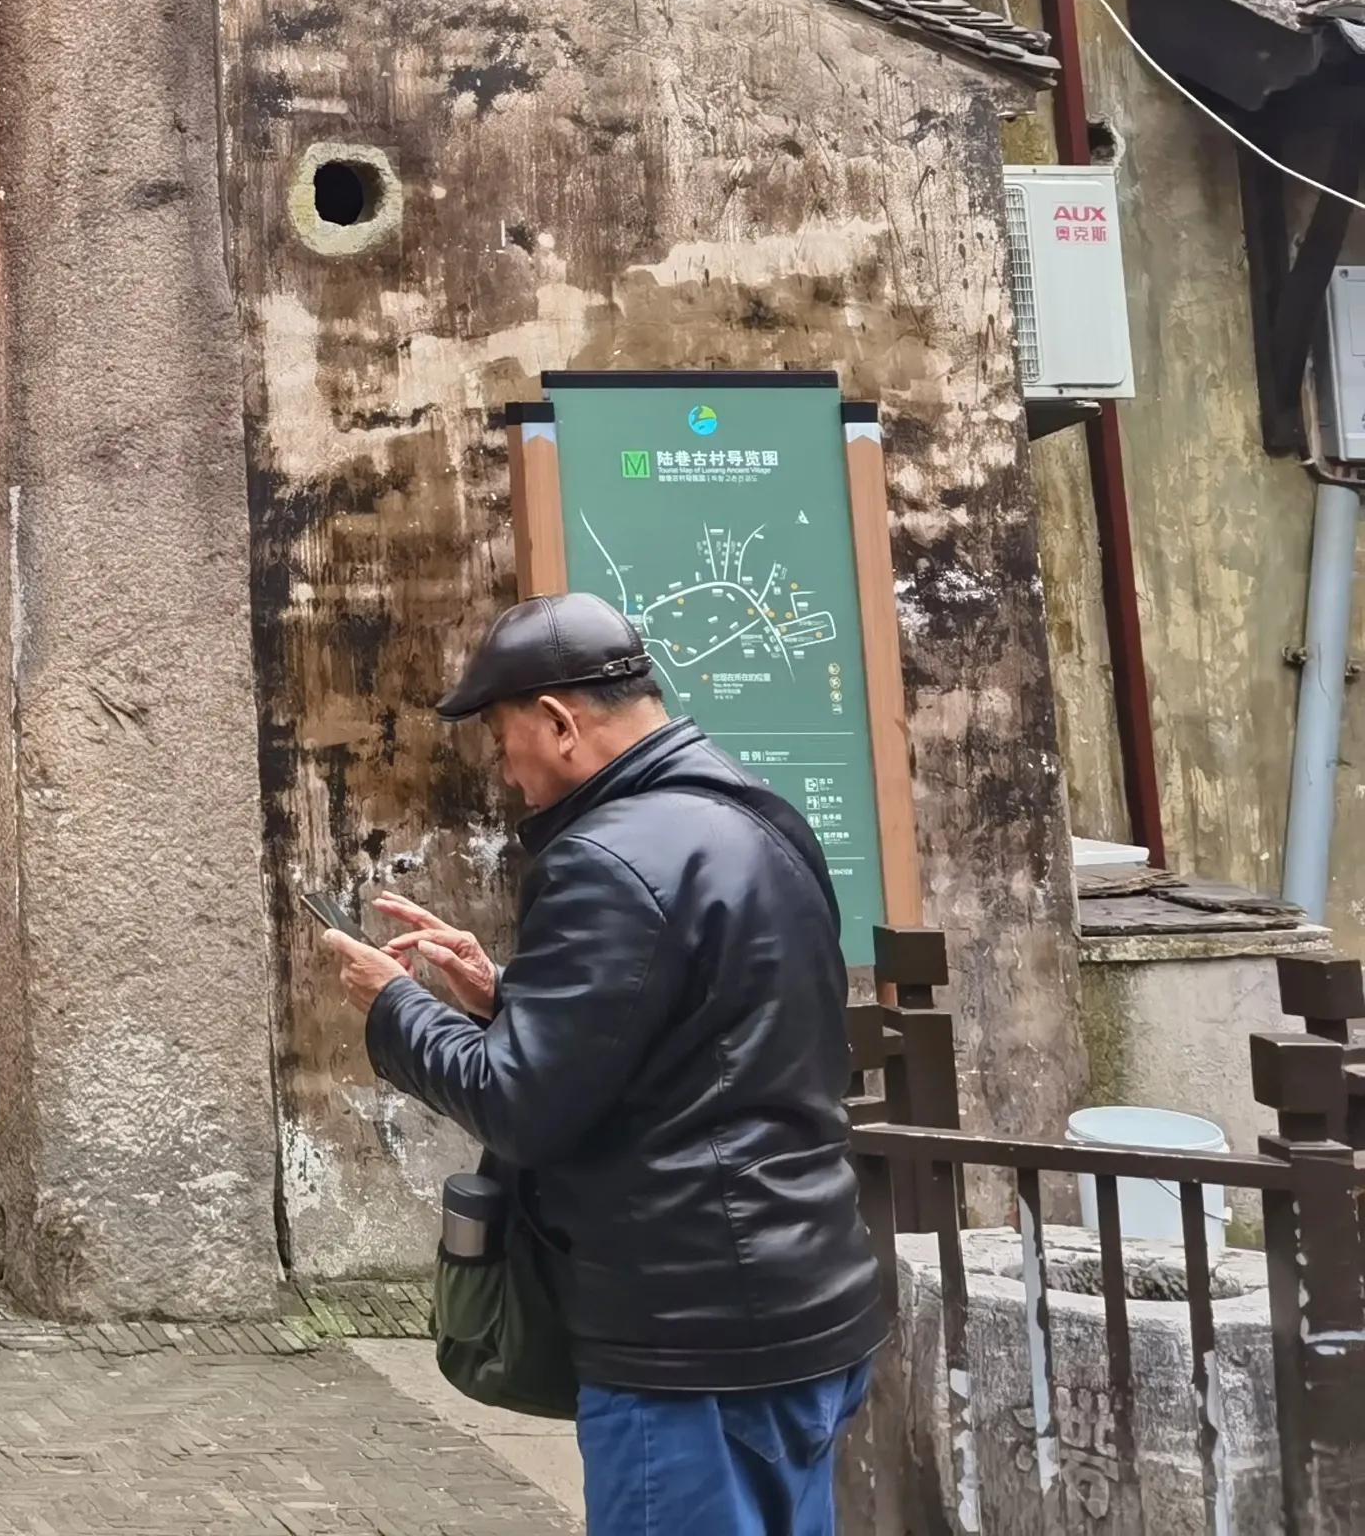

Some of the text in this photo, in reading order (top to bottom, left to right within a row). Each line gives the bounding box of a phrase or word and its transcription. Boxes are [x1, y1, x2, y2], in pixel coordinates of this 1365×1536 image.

[1052, 206, 1107, 222] AUX
[1055, 226, 1107, 241] 奥克斯
[656, 450, 779, 467] 陆巷古村导览图
